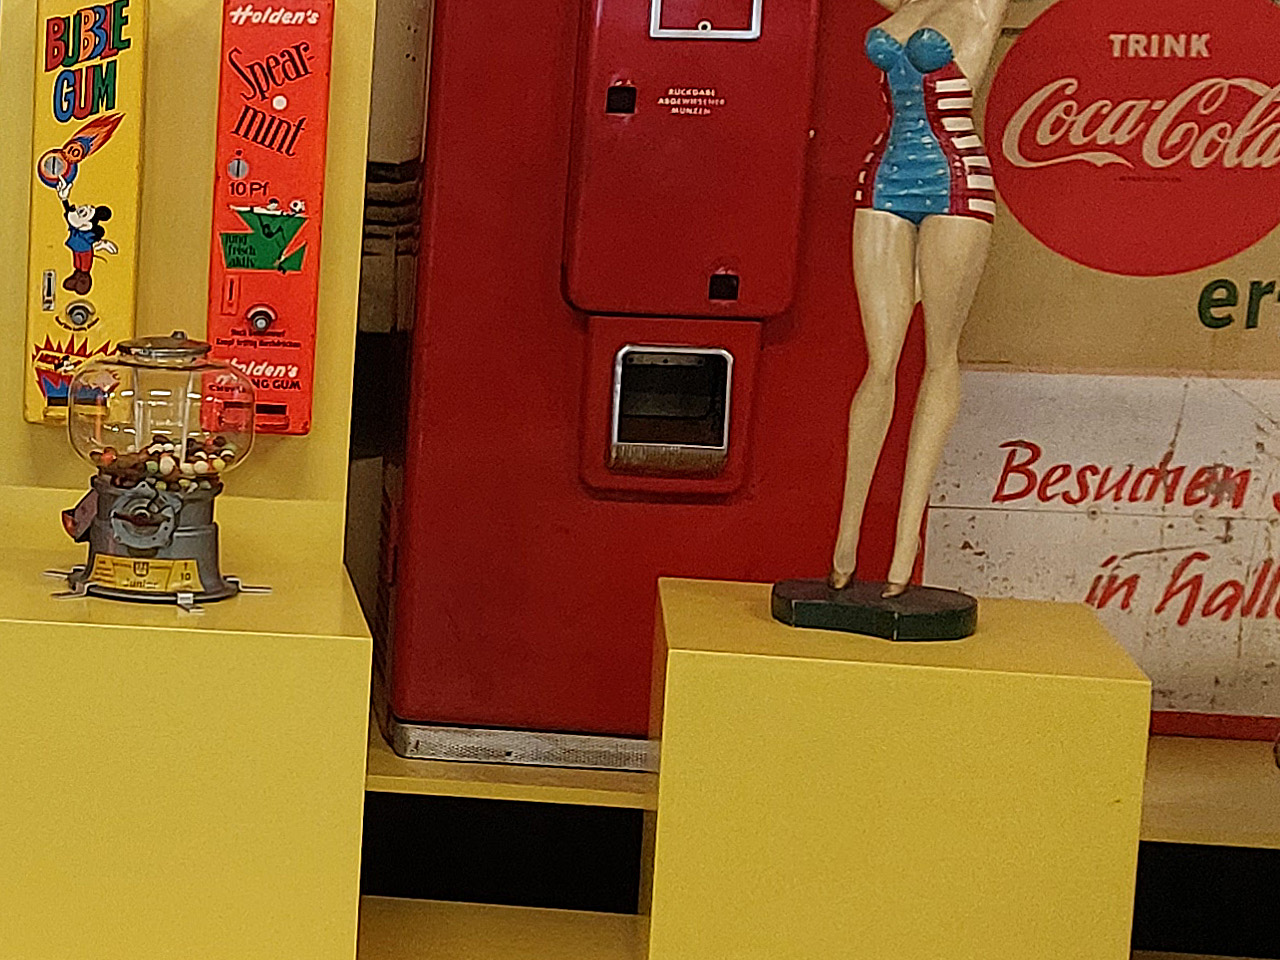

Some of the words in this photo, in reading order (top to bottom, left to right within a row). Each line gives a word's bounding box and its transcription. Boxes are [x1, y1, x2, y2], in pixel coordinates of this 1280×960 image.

[229, 4, 320, 25] Holden's
[228, 41, 315, 102] Spear-
[1109, 33, 1211, 58] TRINK
[53, 58, 118, 123] GUM
[230, 104, 307, 157] mint
[1002, 76, 1280, 169] Coca-Cola
[67, 145, 81, 158] 10
[230, 182, 246, 196] 10
[272, 380, 301, 390] GUM
[992, 440, 1252, 510] Besuchen
[1084, 554, 1141, 610] in
